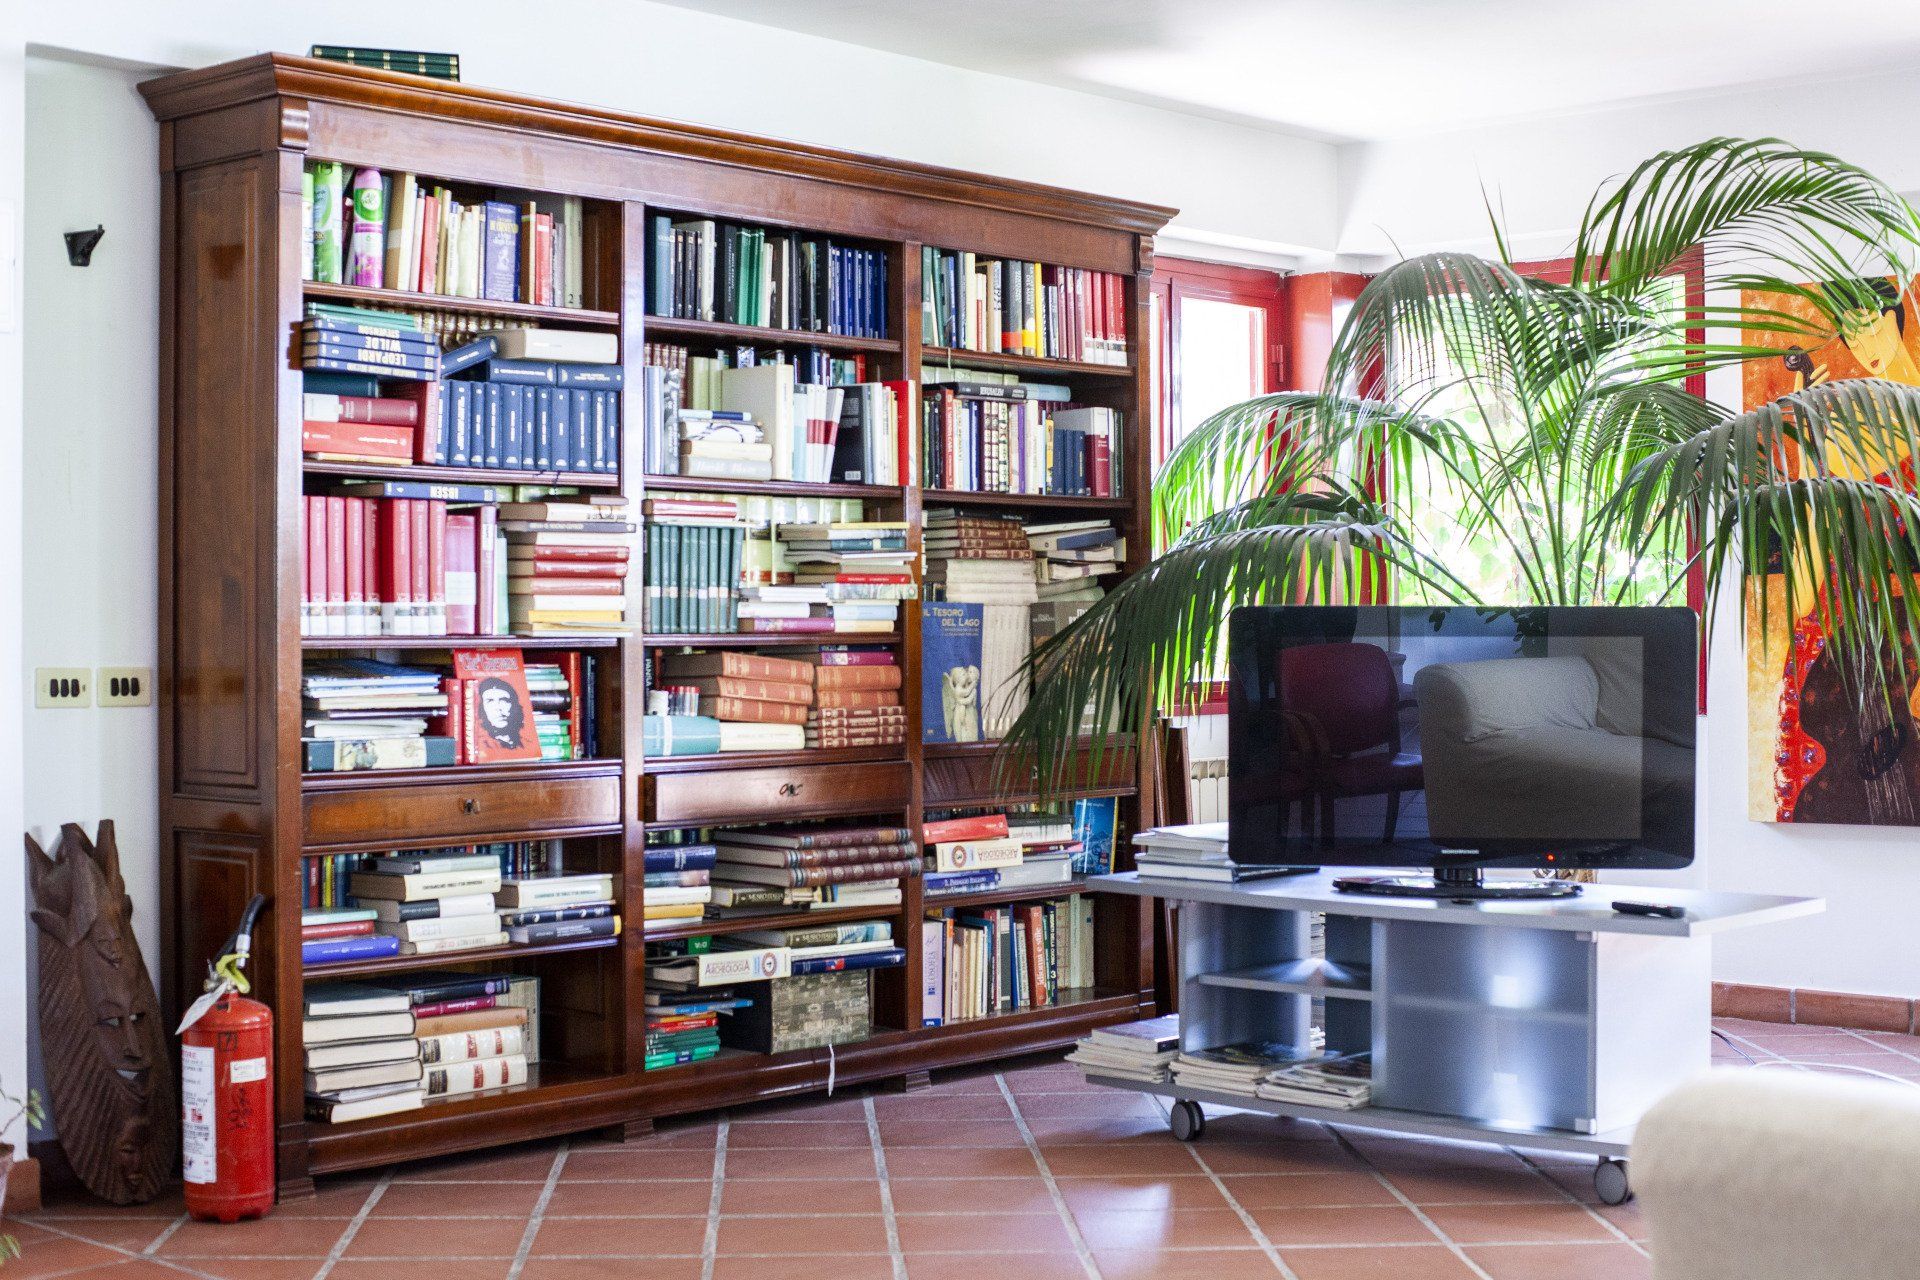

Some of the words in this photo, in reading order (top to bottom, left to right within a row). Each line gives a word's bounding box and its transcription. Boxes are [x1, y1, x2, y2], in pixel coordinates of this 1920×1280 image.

[365, 337, 402, 352] WILDE
[358, 349, 407, 366] LEOPARDI
[932, 607, 964, 617] TESORO
[942, 618, 956, 627] DEL
[958, 617, 980, 627] LAGO
